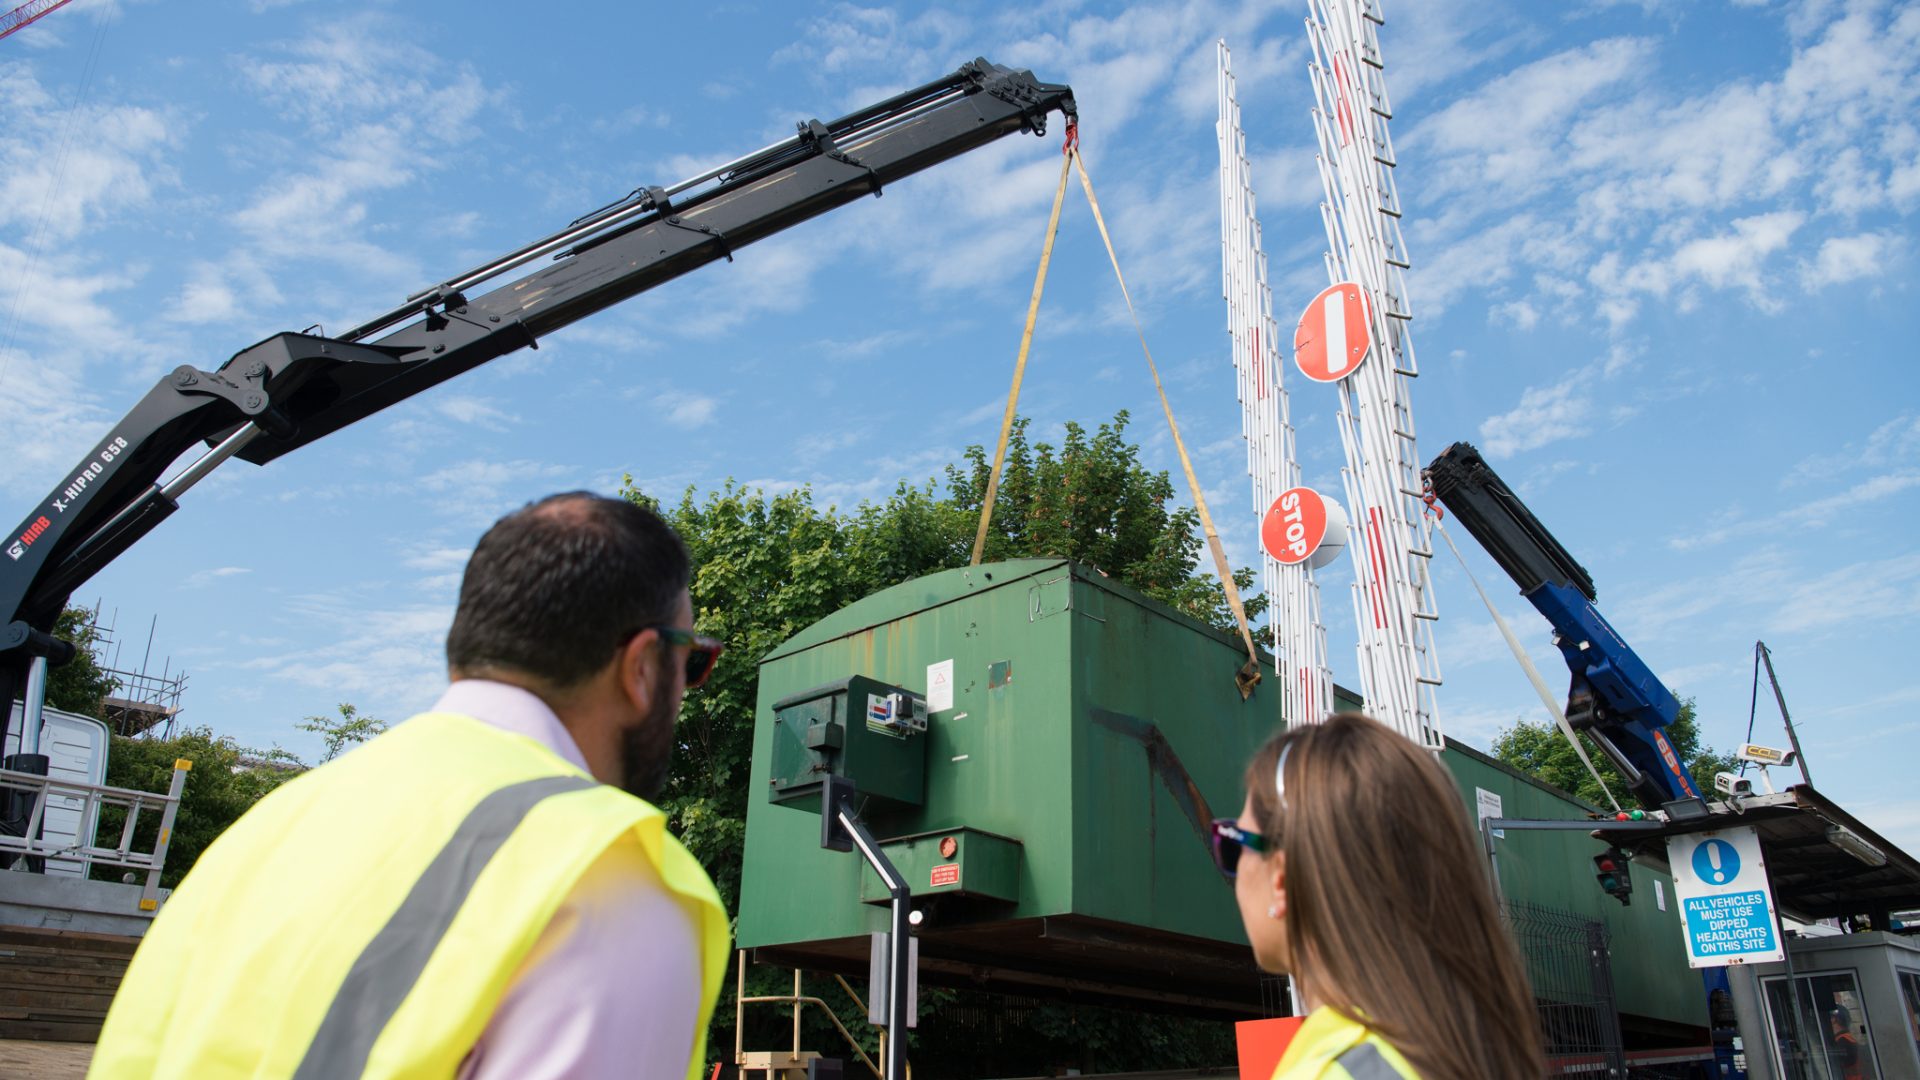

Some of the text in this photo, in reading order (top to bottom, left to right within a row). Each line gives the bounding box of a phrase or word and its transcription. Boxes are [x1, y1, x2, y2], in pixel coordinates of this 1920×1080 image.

[20, 436, 129, 546] HIAB X-HIPRO 658
[1281, 492, 1307, 557] STOP
[1689, 894, 1763, 911] ALL VEHICLES
[1701, 906, 1754, 921] MUST USE
[1709, 918, 1749, 931] DIPPED
[1696, 928, 1767, 943] HEADLIGHTS
[1700, 938, 1766, 953] ON THIS SITE
